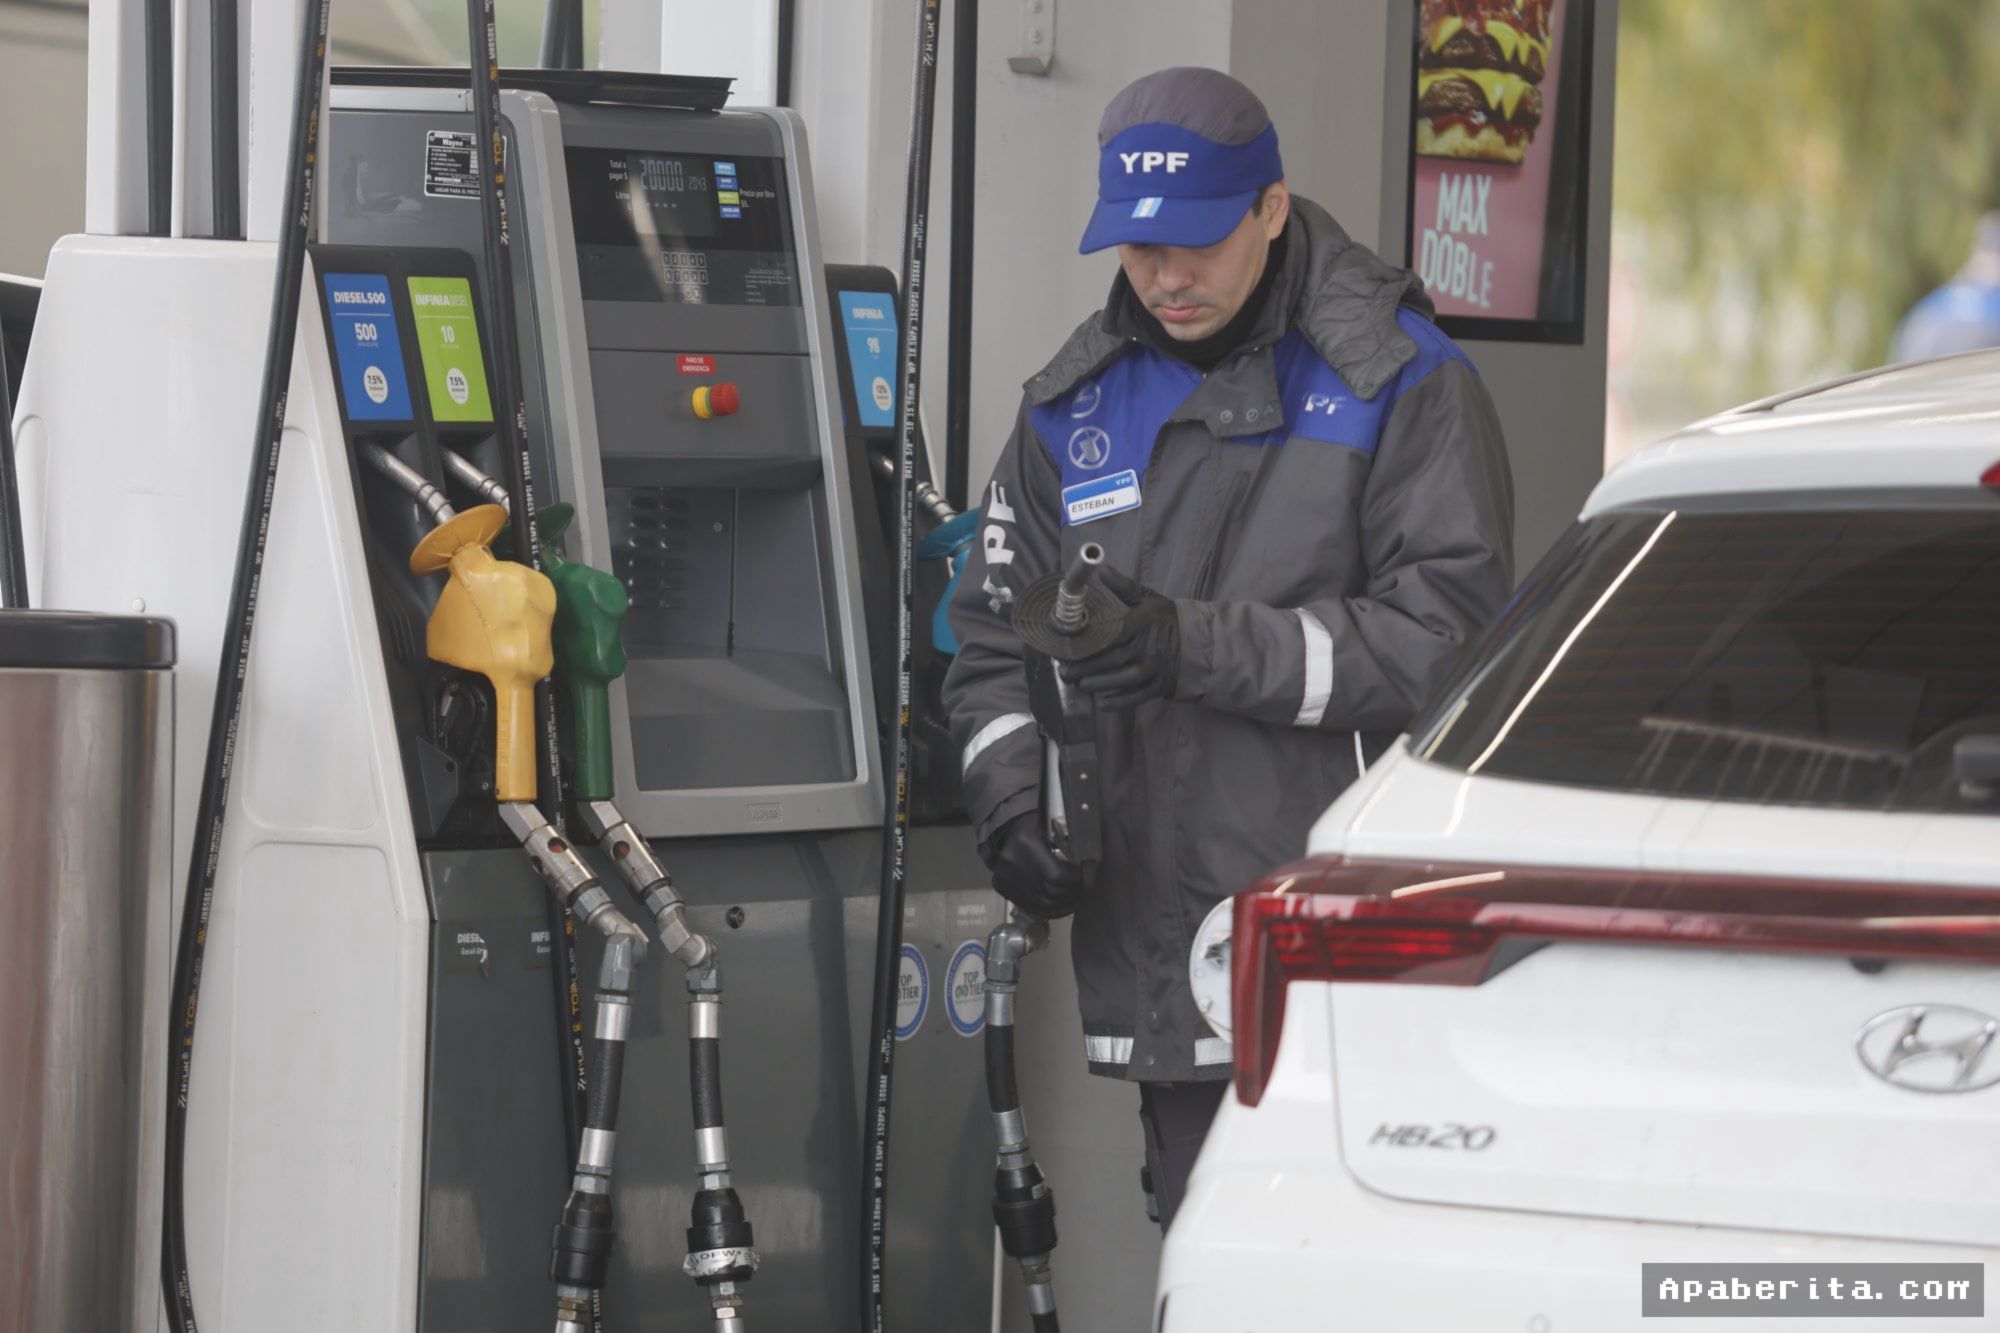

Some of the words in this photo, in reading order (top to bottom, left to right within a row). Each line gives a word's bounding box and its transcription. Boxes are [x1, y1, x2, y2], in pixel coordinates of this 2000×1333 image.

[442, 138, 463, 148] Wayne
[1119, 152, 1190, 174] YPF
[1436, 172, 1493, 236] MAX
[1419, 229, 1495, 310] DOBLE
[852, 307, 885, 320] INFINIA
[354, 322, 378, 341] 500
[440, 325, 455, 343] 10
[866, 337, 881, 354] 98
[1115, 476, 1132, 487] YPF
[1071, 496, 1115, 513] ESTEBAN
[963, 971, 980, 983] TOP
[902, 986, 919, 999] TIER
[1368, 1123, 1497, 1151] HB20
